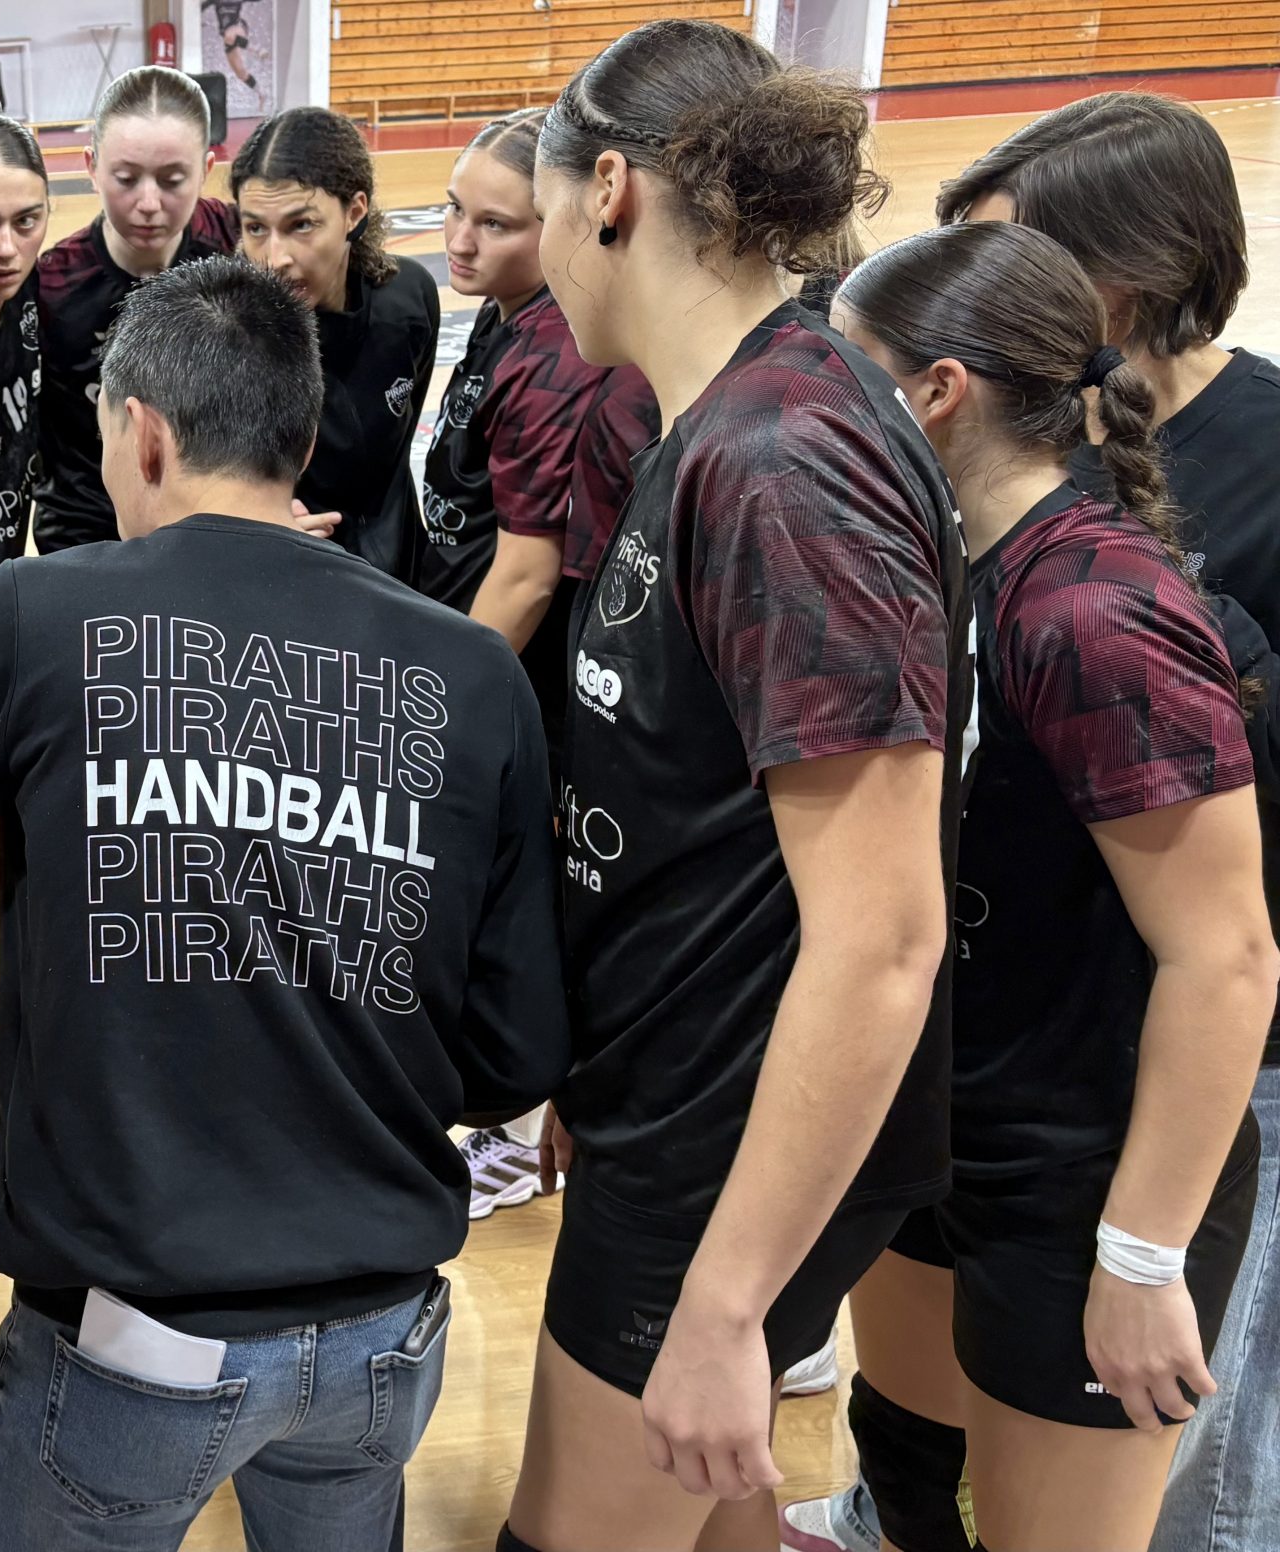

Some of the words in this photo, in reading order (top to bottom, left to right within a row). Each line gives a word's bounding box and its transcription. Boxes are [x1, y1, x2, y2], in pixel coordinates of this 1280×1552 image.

[83, 614, 448, 730] PIRATHS
[84, 684, 446, 800] PIRATHS
[85, 758, 436, 871] HANDBALL
[86, 832, 431, 942] PIRATHS
[89, 912, 421, 1015] PIRATHS
